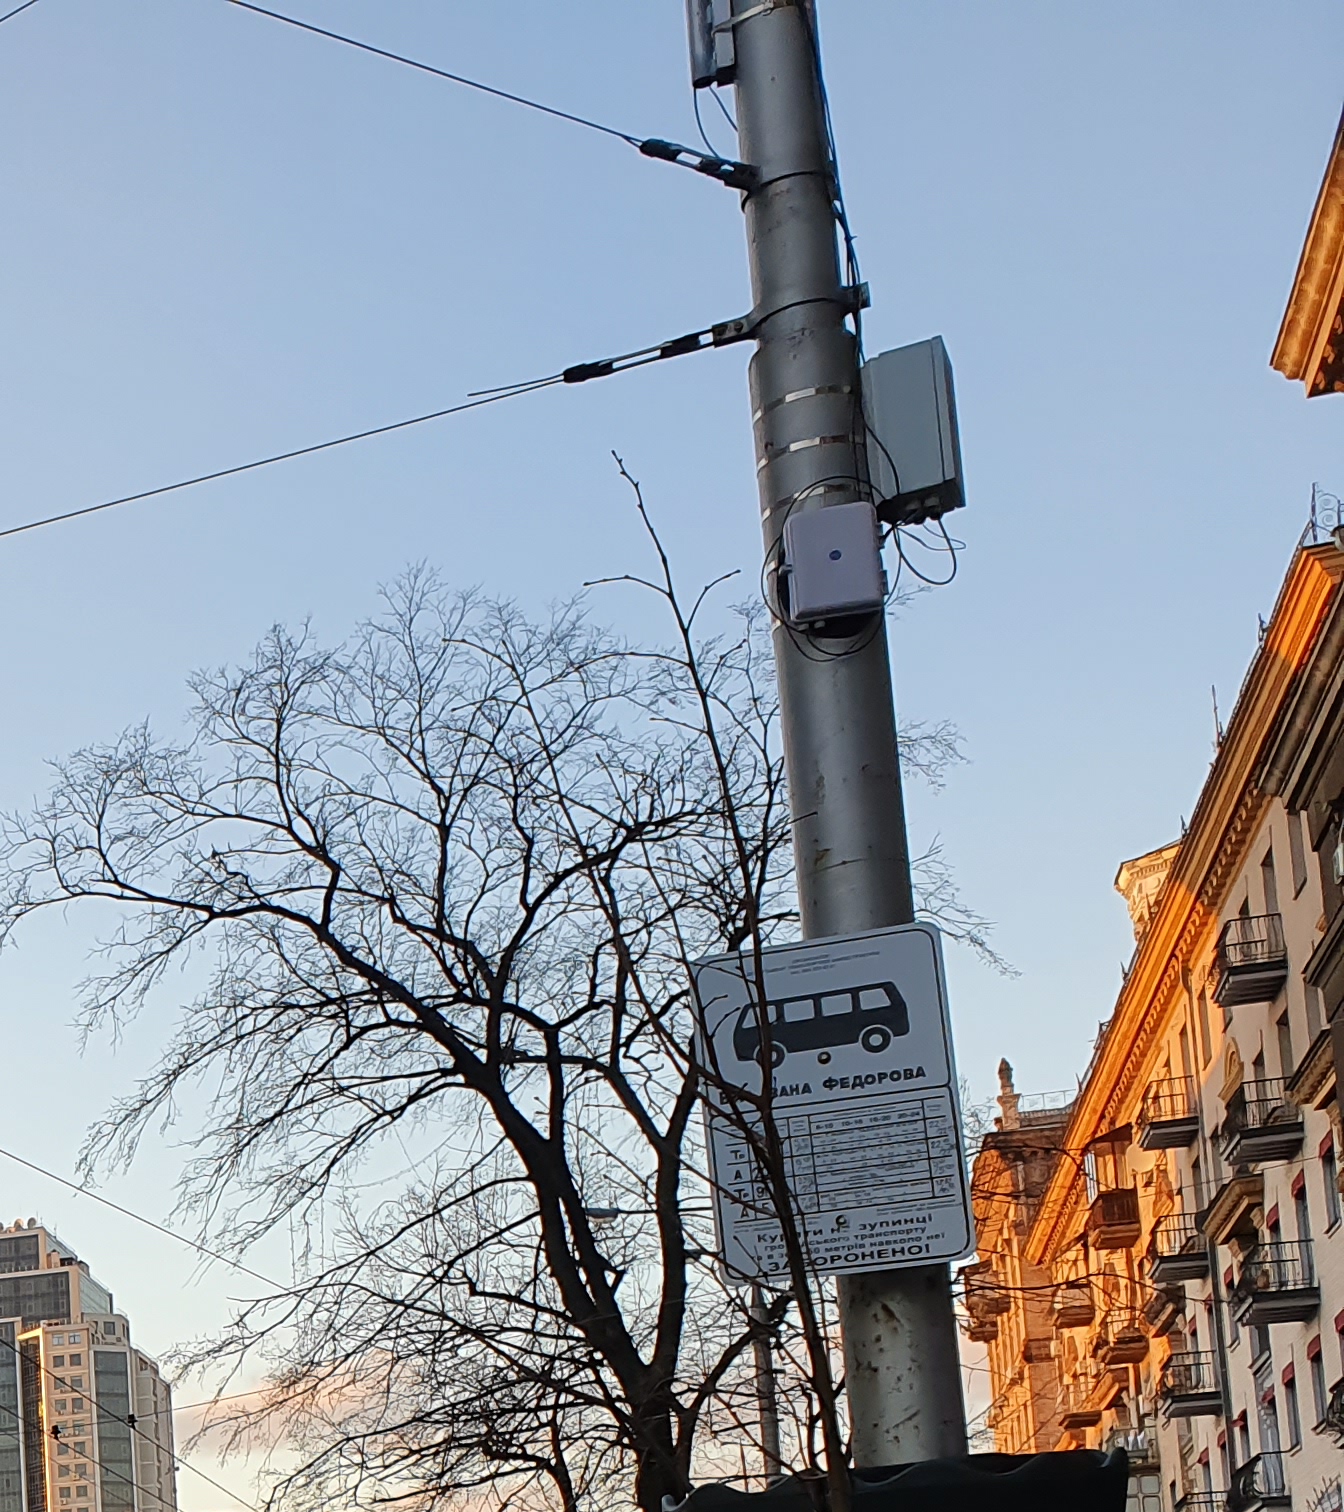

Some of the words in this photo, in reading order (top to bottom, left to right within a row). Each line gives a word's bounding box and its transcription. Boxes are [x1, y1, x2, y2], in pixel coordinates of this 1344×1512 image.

[823, 1065, 927, 1091] ФЕДОРОВА
[757, 1227, 823, 1244] Кути
[858, 1213, 933, 1232] зупинці
[764, 1235, 850, 1252] гроського
[853, 1226, 927, 1241] транспорту
[824, 1241, 866, 1253] метрів
[869, 1236, 923, 1248] навколо
